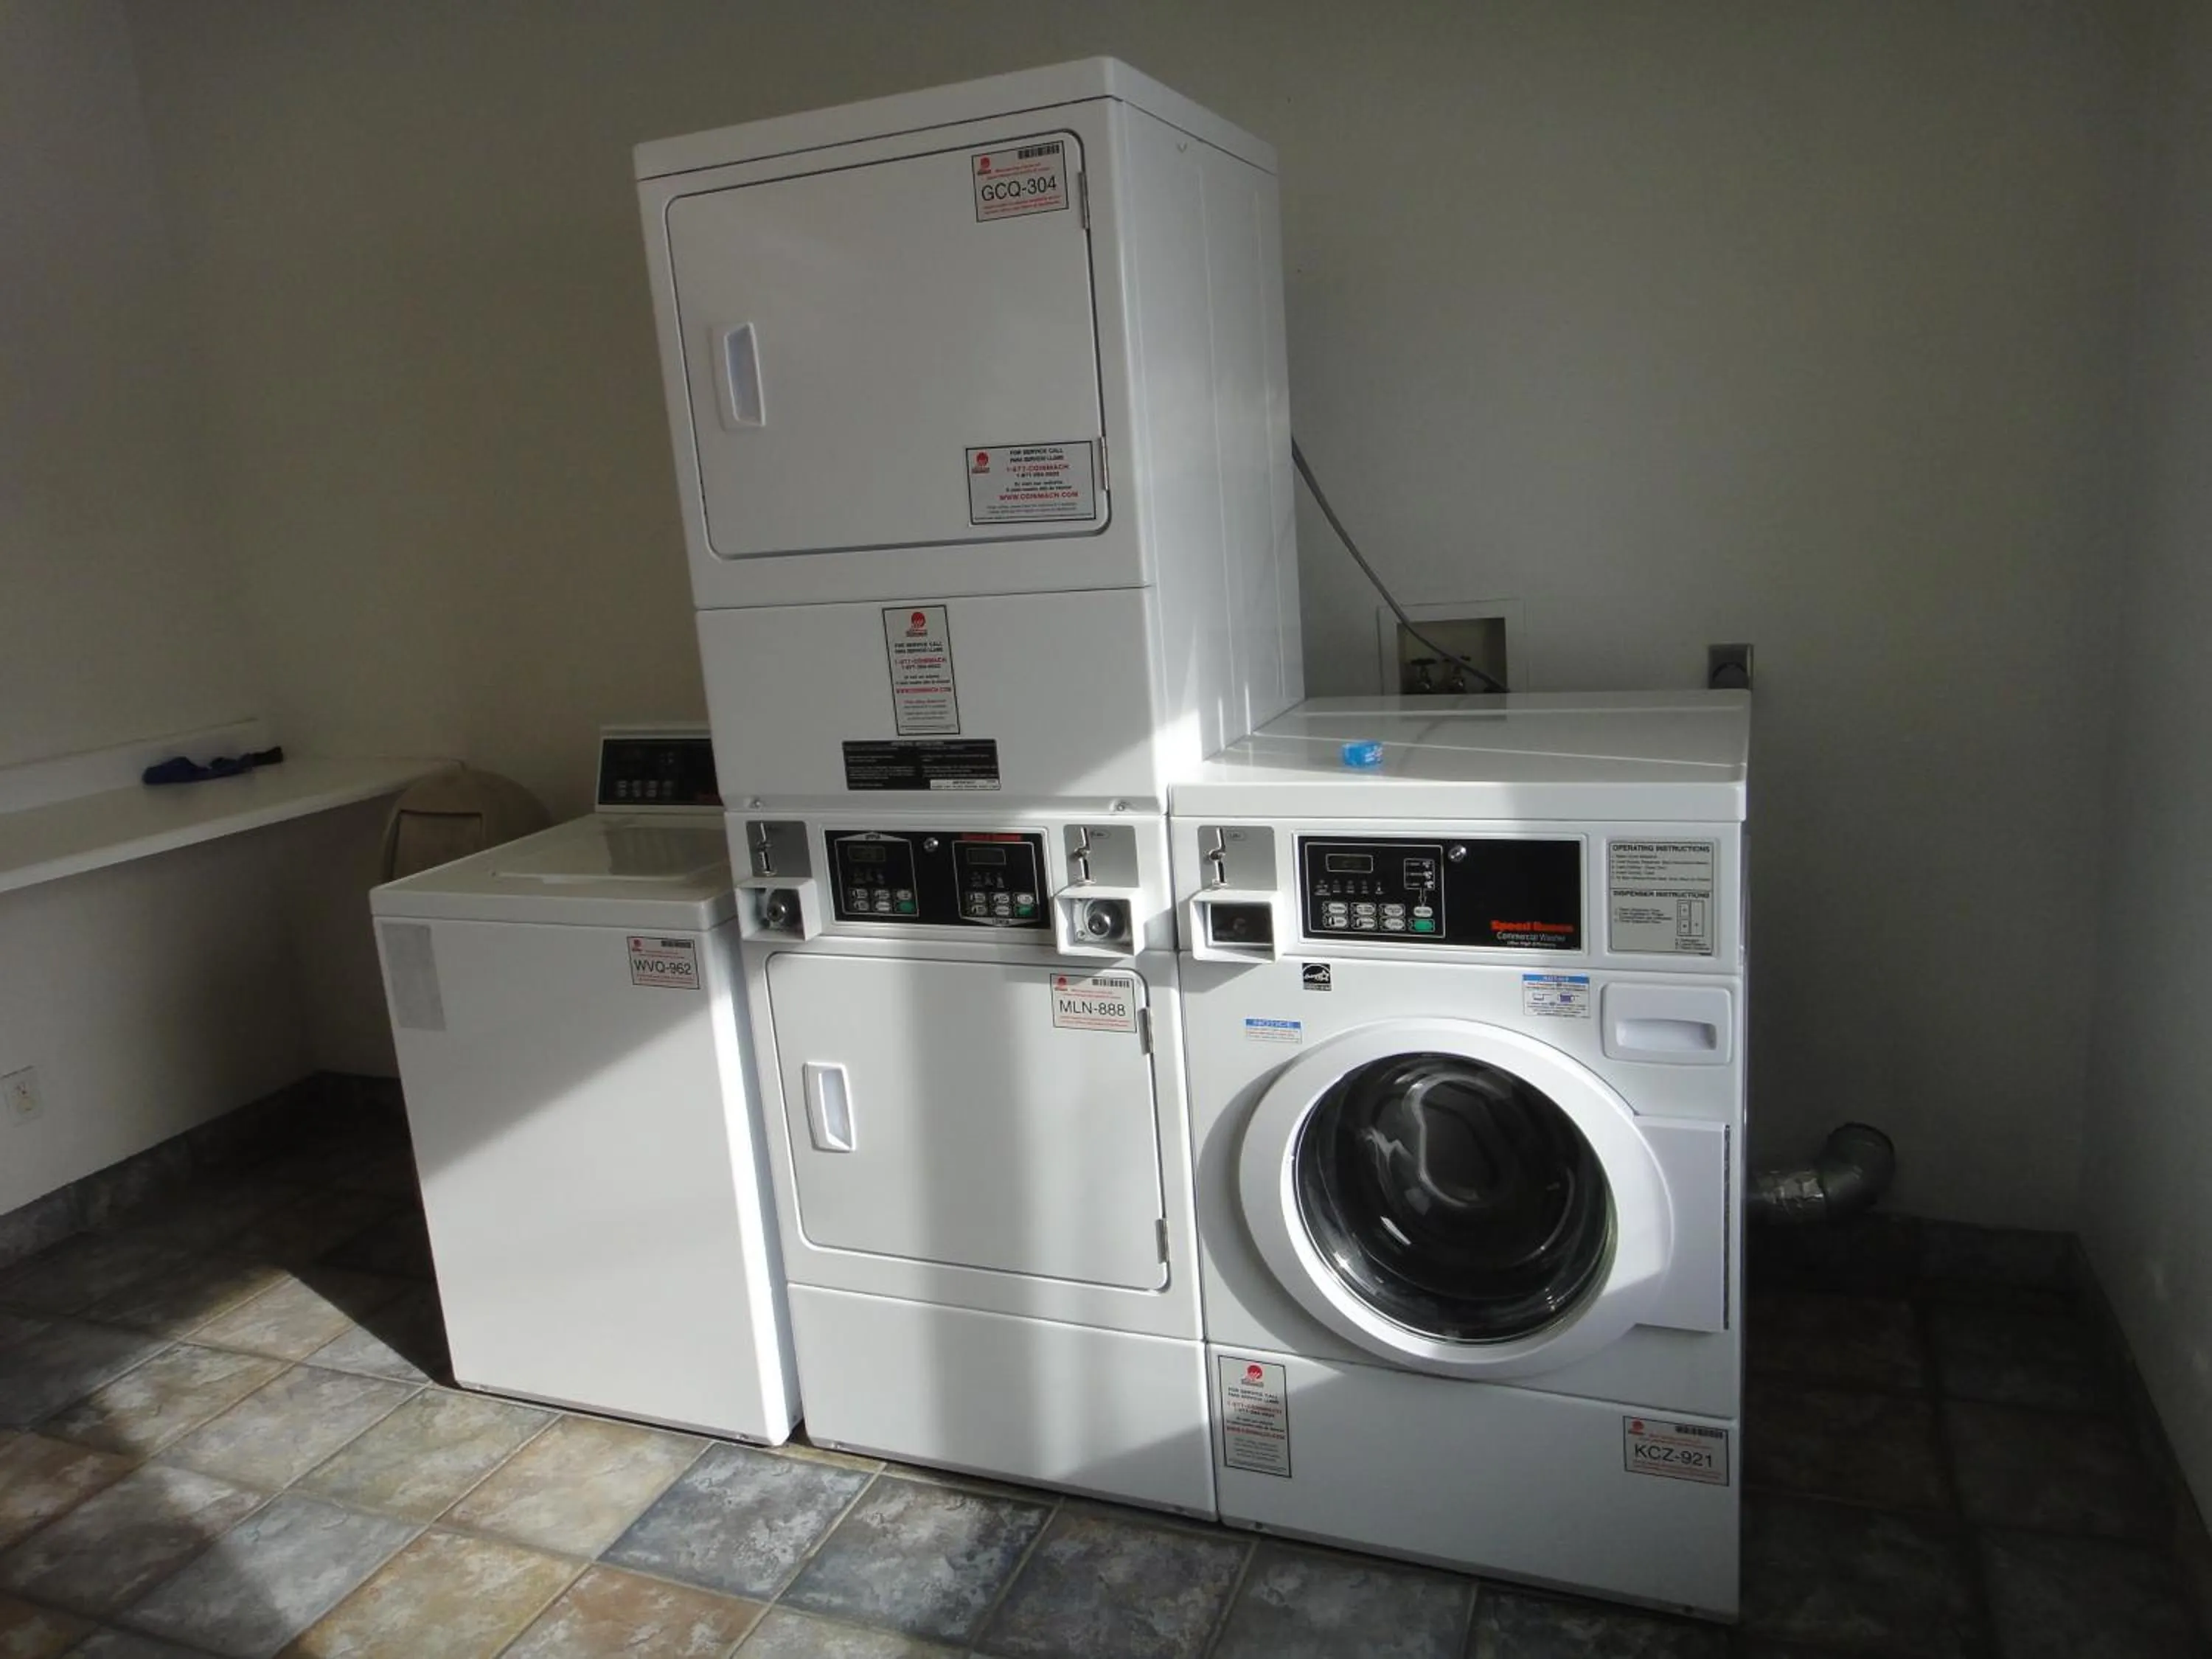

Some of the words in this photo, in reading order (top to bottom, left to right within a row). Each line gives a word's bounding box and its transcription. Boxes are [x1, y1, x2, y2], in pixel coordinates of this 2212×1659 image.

[981, 175, 1057, 201] GCQ-304
[633, 959, 692, 975] WVQ-962
[1060, 999, 1126, 1017] MLN-888
[1635, 1443, 1712, 1468] KCZ-921
